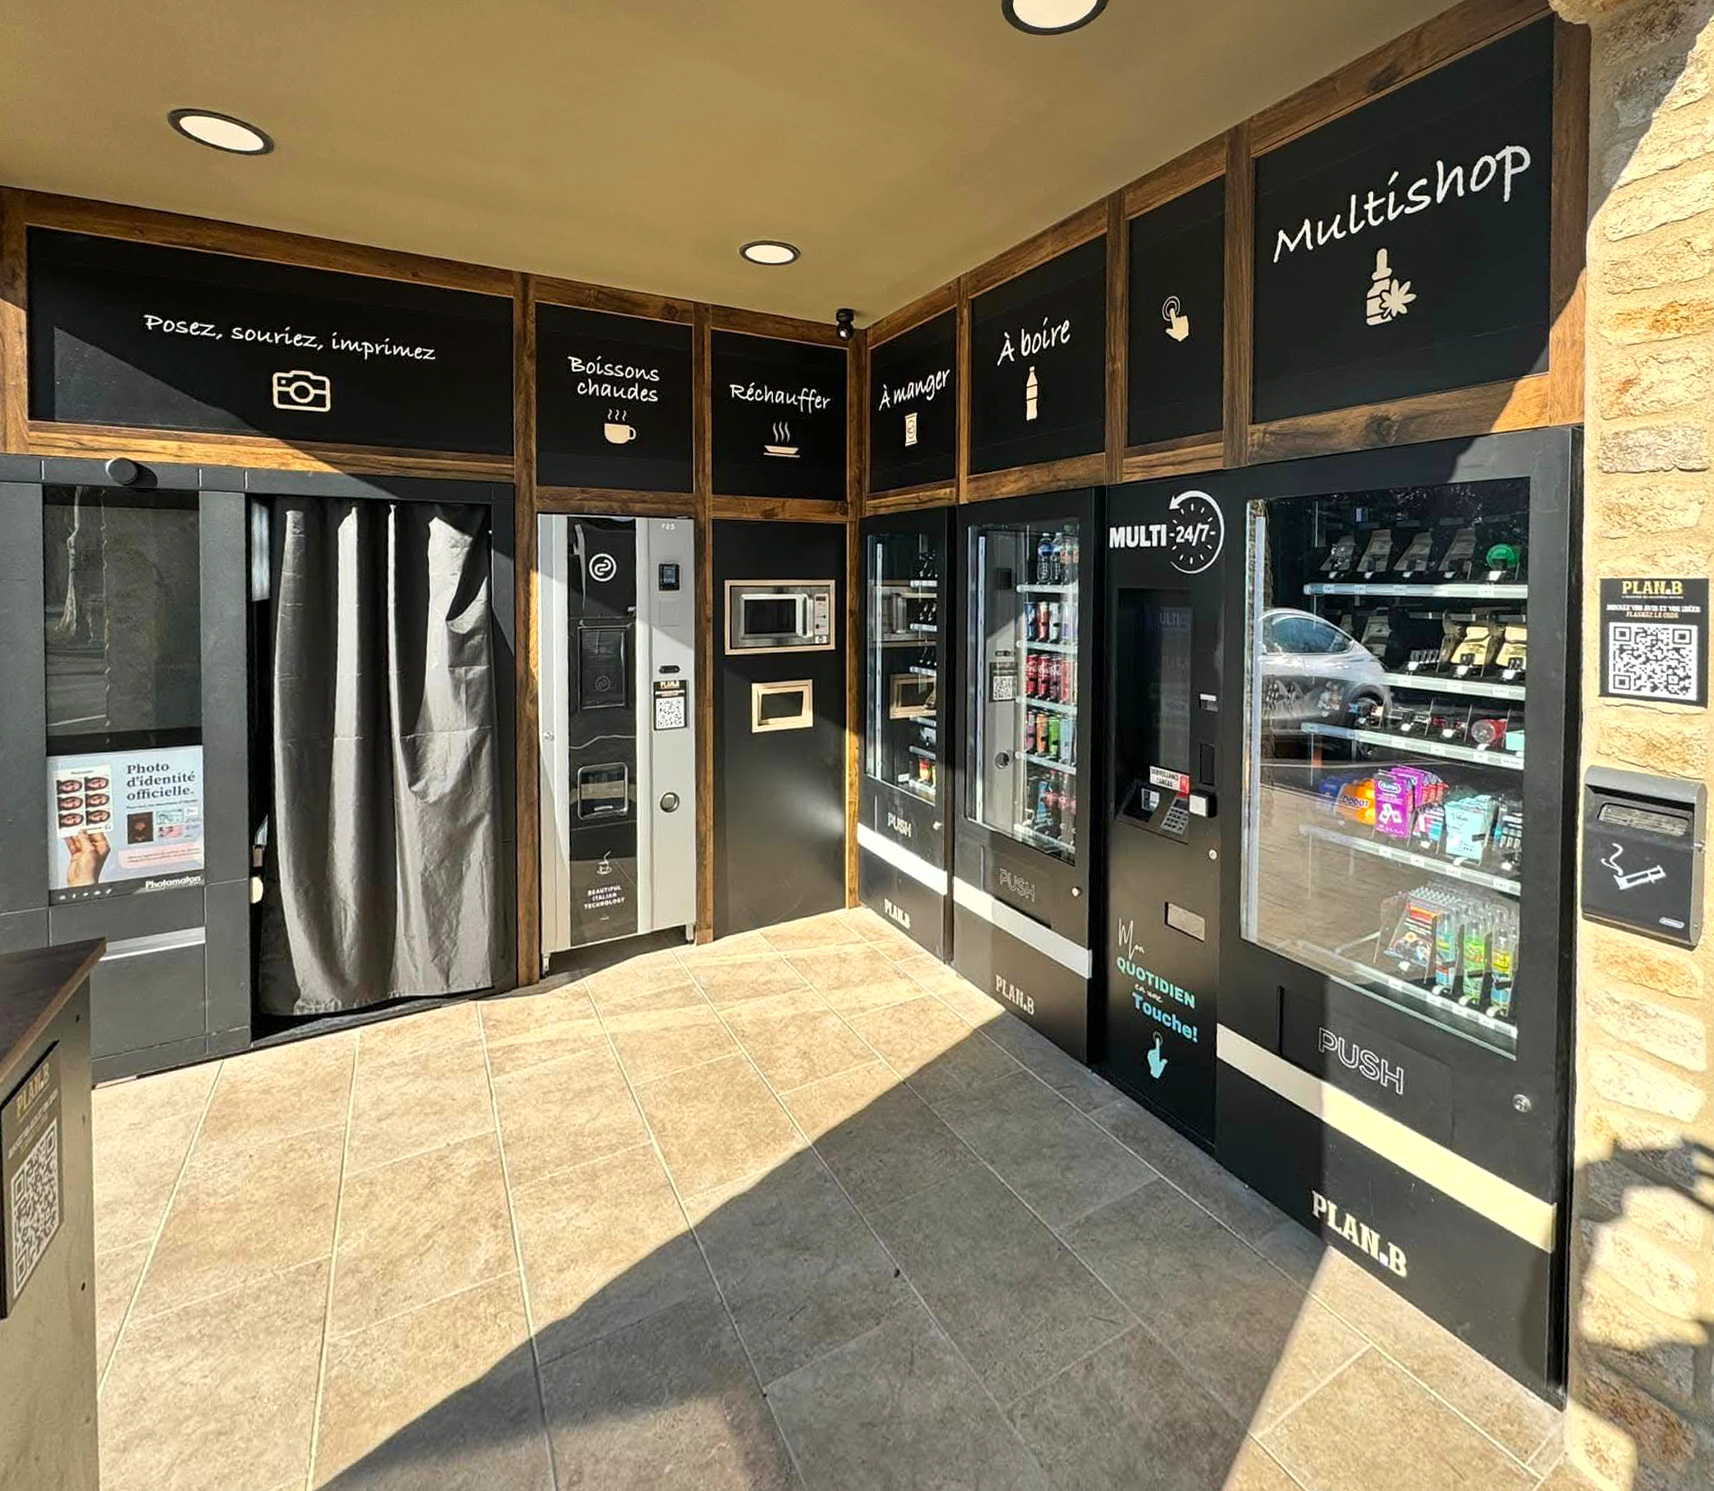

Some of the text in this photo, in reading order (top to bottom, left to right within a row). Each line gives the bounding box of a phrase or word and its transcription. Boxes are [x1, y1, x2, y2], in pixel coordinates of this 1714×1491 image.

[1272, 145, 1532, 264] Multishop
[143, 313, 437, 361] Posez, souriez, imprimez
[996, 316, 1071, 367] À boire
[566, 355, 661, 382] Boissons
[576, 378, 659, 403] chaudes
[728, 381, 832, 414] Réchauffer
[878, 368, 951, 412] À manger
[1109, 522, 1210, 549] MULTI 24/7
[1621, 580, 1684, 596] PLAN.B
[126, 762, 169, 775] Photo
[126, 771, 196, 788] d'identité
[126, 785, 195, 801] officielle.
[887, 811, 912, 838] PUSH
[145, 876, 201, 889] Photomaton
[587, 885, 622, 896] BEAUTIFUL
[592, 892, 617, 901] ITALIAN
[999, 868, 1037, 903] PUSH
[584, 897, 625, 910] TECHNOLOGY
[995, 974, 1036, 1016] PLAN.B
[1116, 956, 1196, 1010] QUOTIDIEN
[1131, 992, 1199, 1043] Touche!
[1317, 1026, 1405, 1096] PUSH
[16, 1062, 50, 1119] PLAN.B
[1310, 1189, 1409, 1279] PLAN.B
